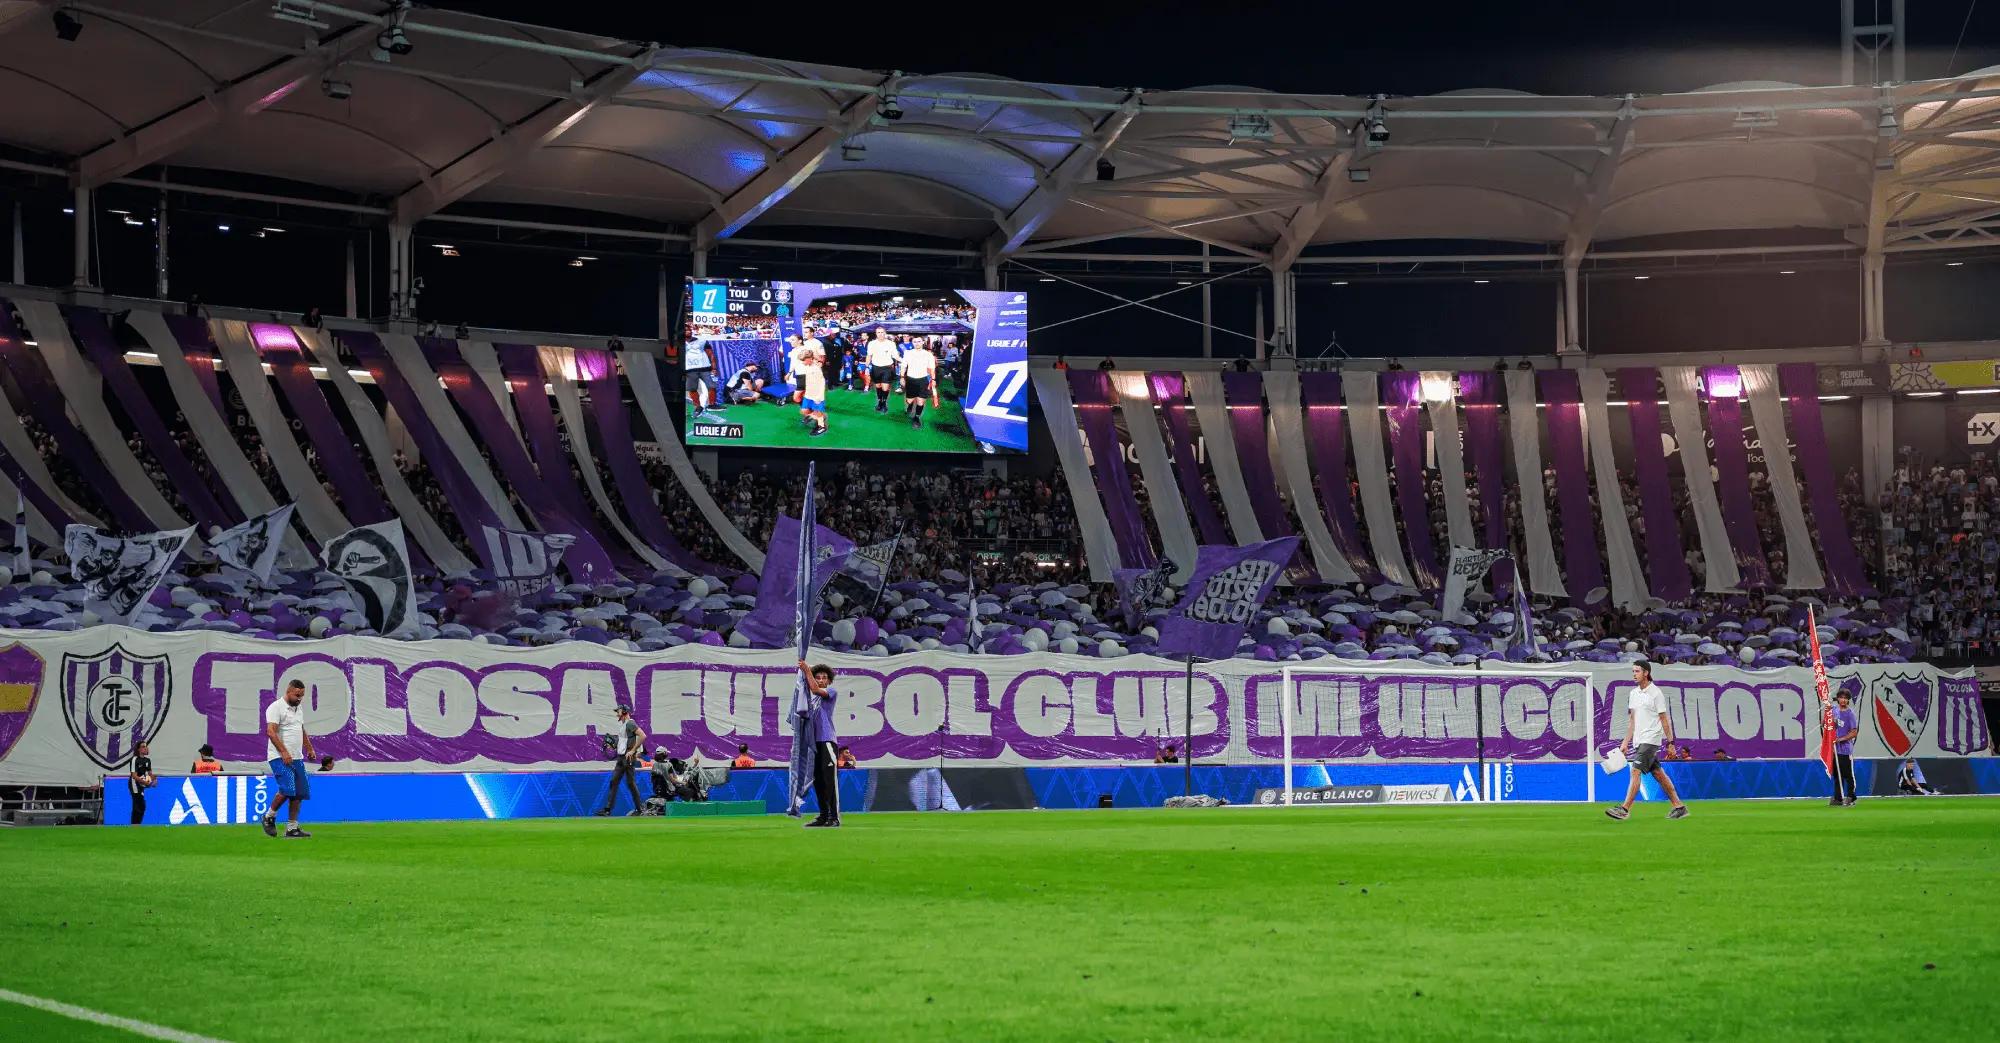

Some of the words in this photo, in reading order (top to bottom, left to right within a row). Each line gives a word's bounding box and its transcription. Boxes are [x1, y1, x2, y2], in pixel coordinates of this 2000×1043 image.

[729, 289, 748, 299] TOU
[761, 289, 772, 301] 0
[729, 303, 744, 312] OM
[761, 303, 772, 315] 0
[695, 315, 725, 324] 00:00
[695, 425, 720, 436] LIGUE
[1944, 682, 1975, 693] TOLOSA
[211, 659, 624, 739] TOLOSA
[650, 669, 992, 738] FUTBOL
[1013, 674, 1219, 738] CLUB
[1257, 680, 1361, 737] MI
[252, 775, 268, 821] .COM
[1323, 789, 1374, 800] BLANCO
[1388, 787, 1439, 801] newrest
